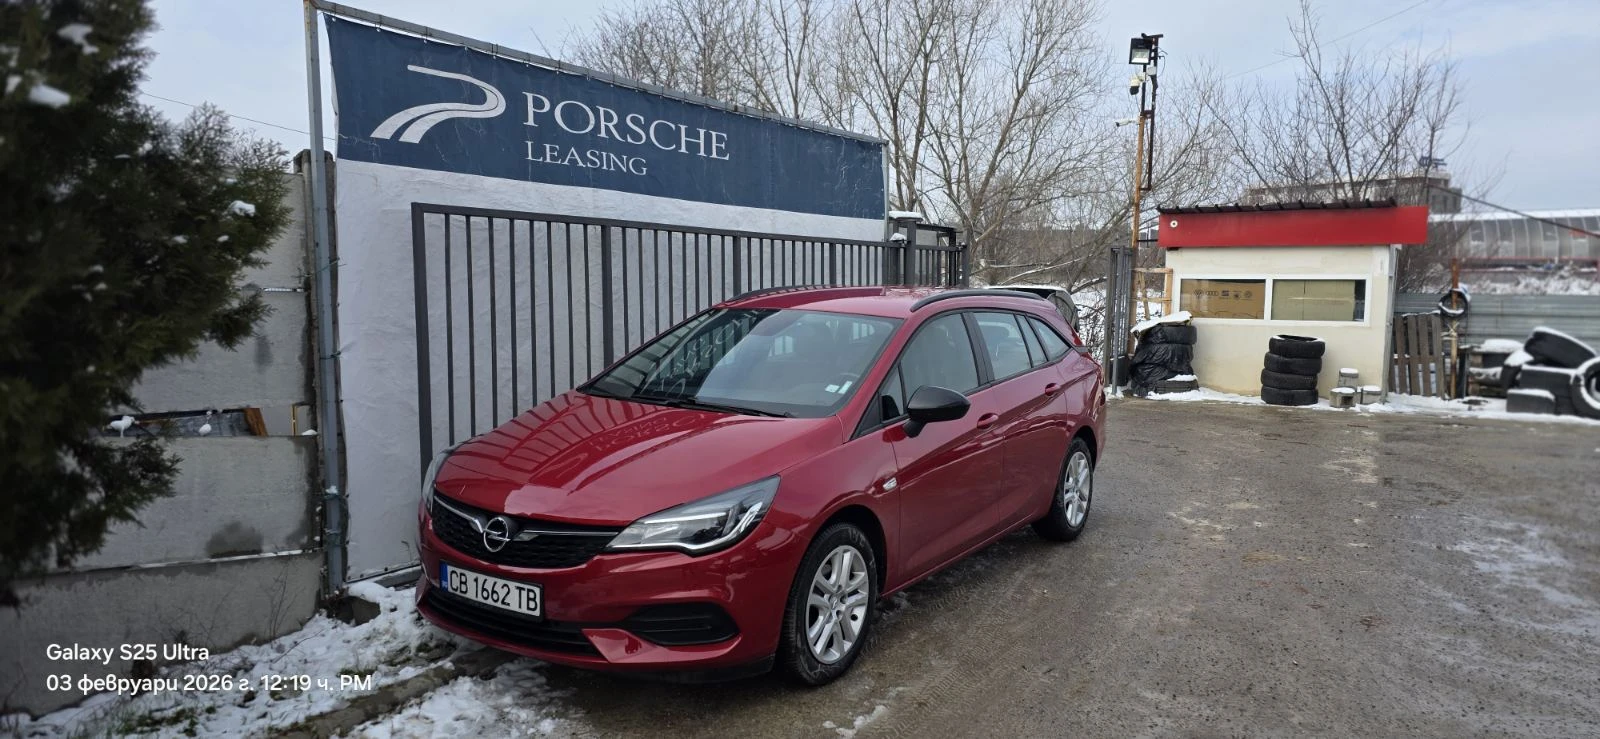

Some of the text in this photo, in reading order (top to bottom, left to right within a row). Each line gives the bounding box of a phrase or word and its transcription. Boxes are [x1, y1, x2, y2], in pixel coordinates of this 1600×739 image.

[522, 91, 730, 161] PORSCHE
[525, 141, 647, 176] LEASING
[449, 569, 538, 612] CB 1662 TB
